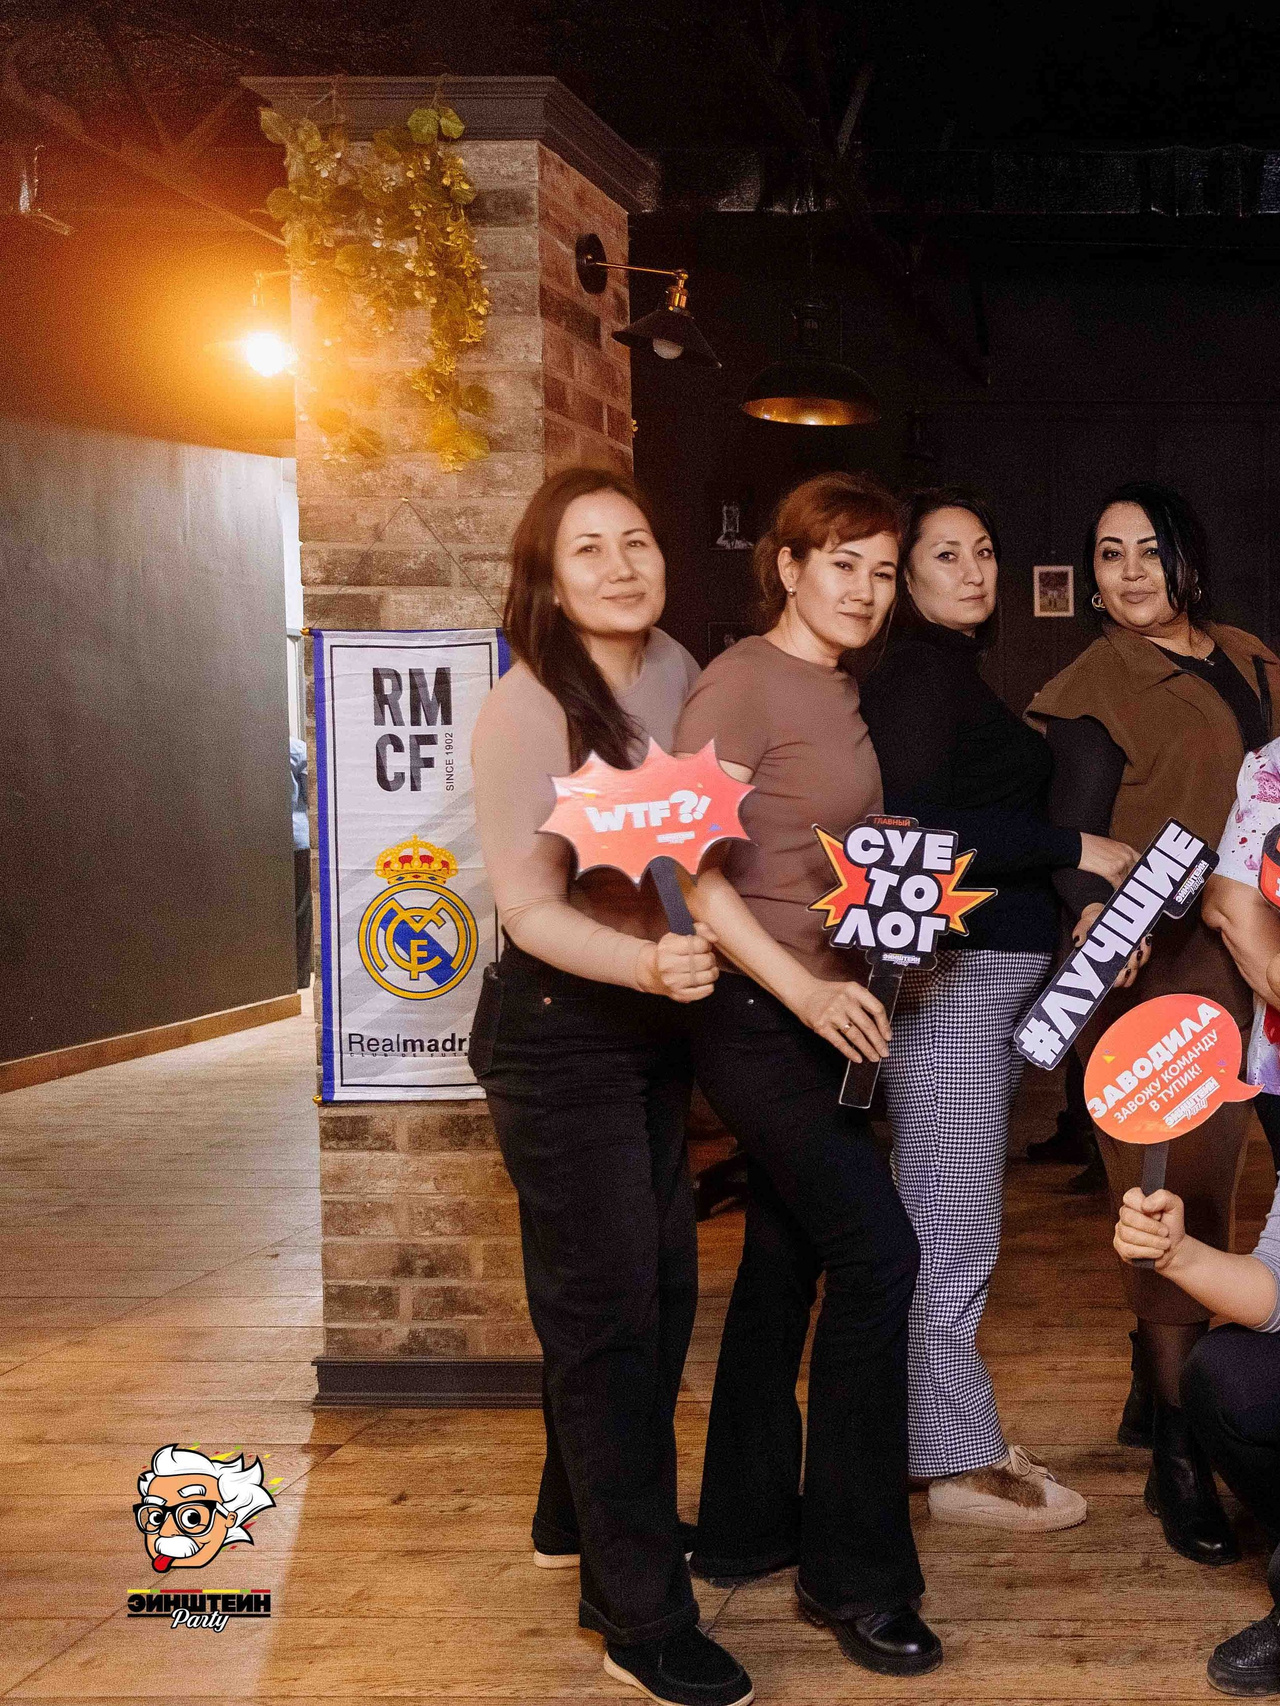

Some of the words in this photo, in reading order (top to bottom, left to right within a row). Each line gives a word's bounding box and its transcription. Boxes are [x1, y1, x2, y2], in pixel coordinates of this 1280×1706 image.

[372, 667, 452, 726] RM
[375, 733, 438, 792] CF
[444, 732, 454, 756] 1902
[445, 759, 455, 791] SINCE
[584, 789, 712, 833] WTF?!
[873, 817, 911, 827] ГЛАВНЫЙ
[1018, 822, 1205, 1062] #ЛУЧШИЕ
[1087, 1003, 1221, 1119] ЗАВОДИЛА
[1113, 1078, 1162, 1124] ЗАВОЖУ
[1160, 1029, 1218, 1084] КОМАНДУ
[1148, 1097, 1161, 1112] В
[1158, 1063, 1203, 1103] ТУПИК!
